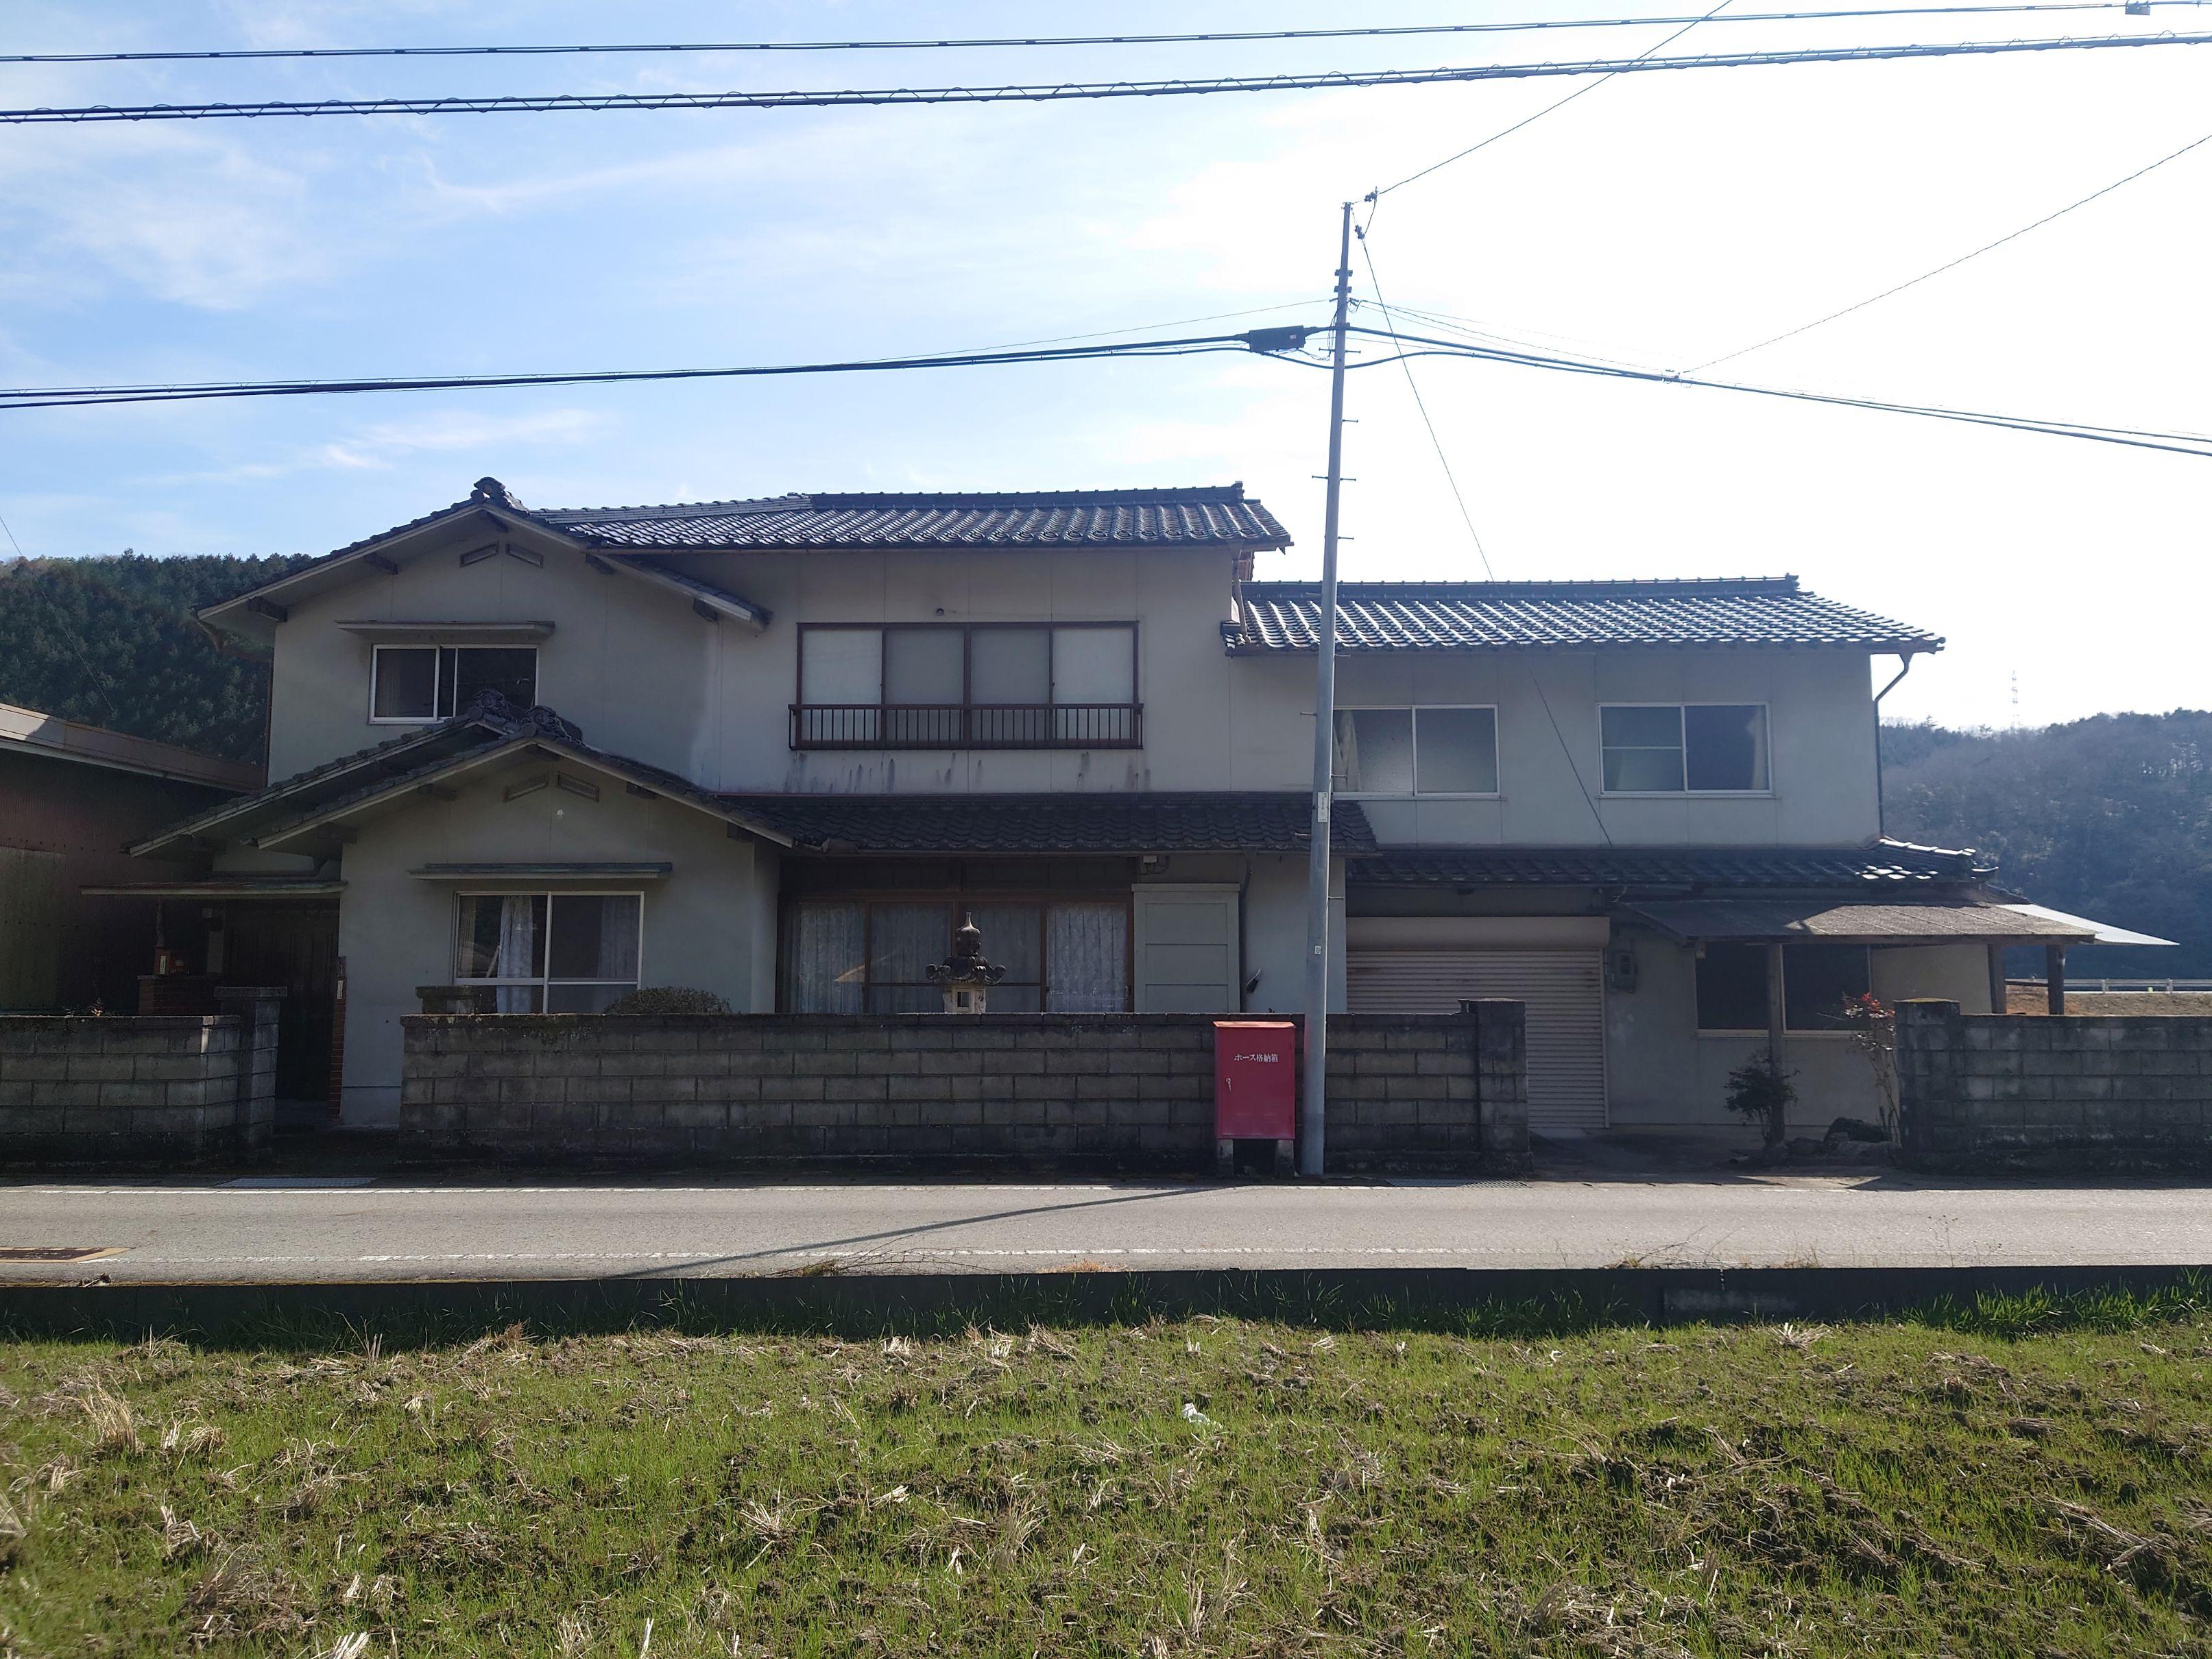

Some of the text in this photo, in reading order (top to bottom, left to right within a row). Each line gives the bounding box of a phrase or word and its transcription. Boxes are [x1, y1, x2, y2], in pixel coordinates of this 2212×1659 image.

[1234, 1053, 1279, 1063] ホース格納箱
